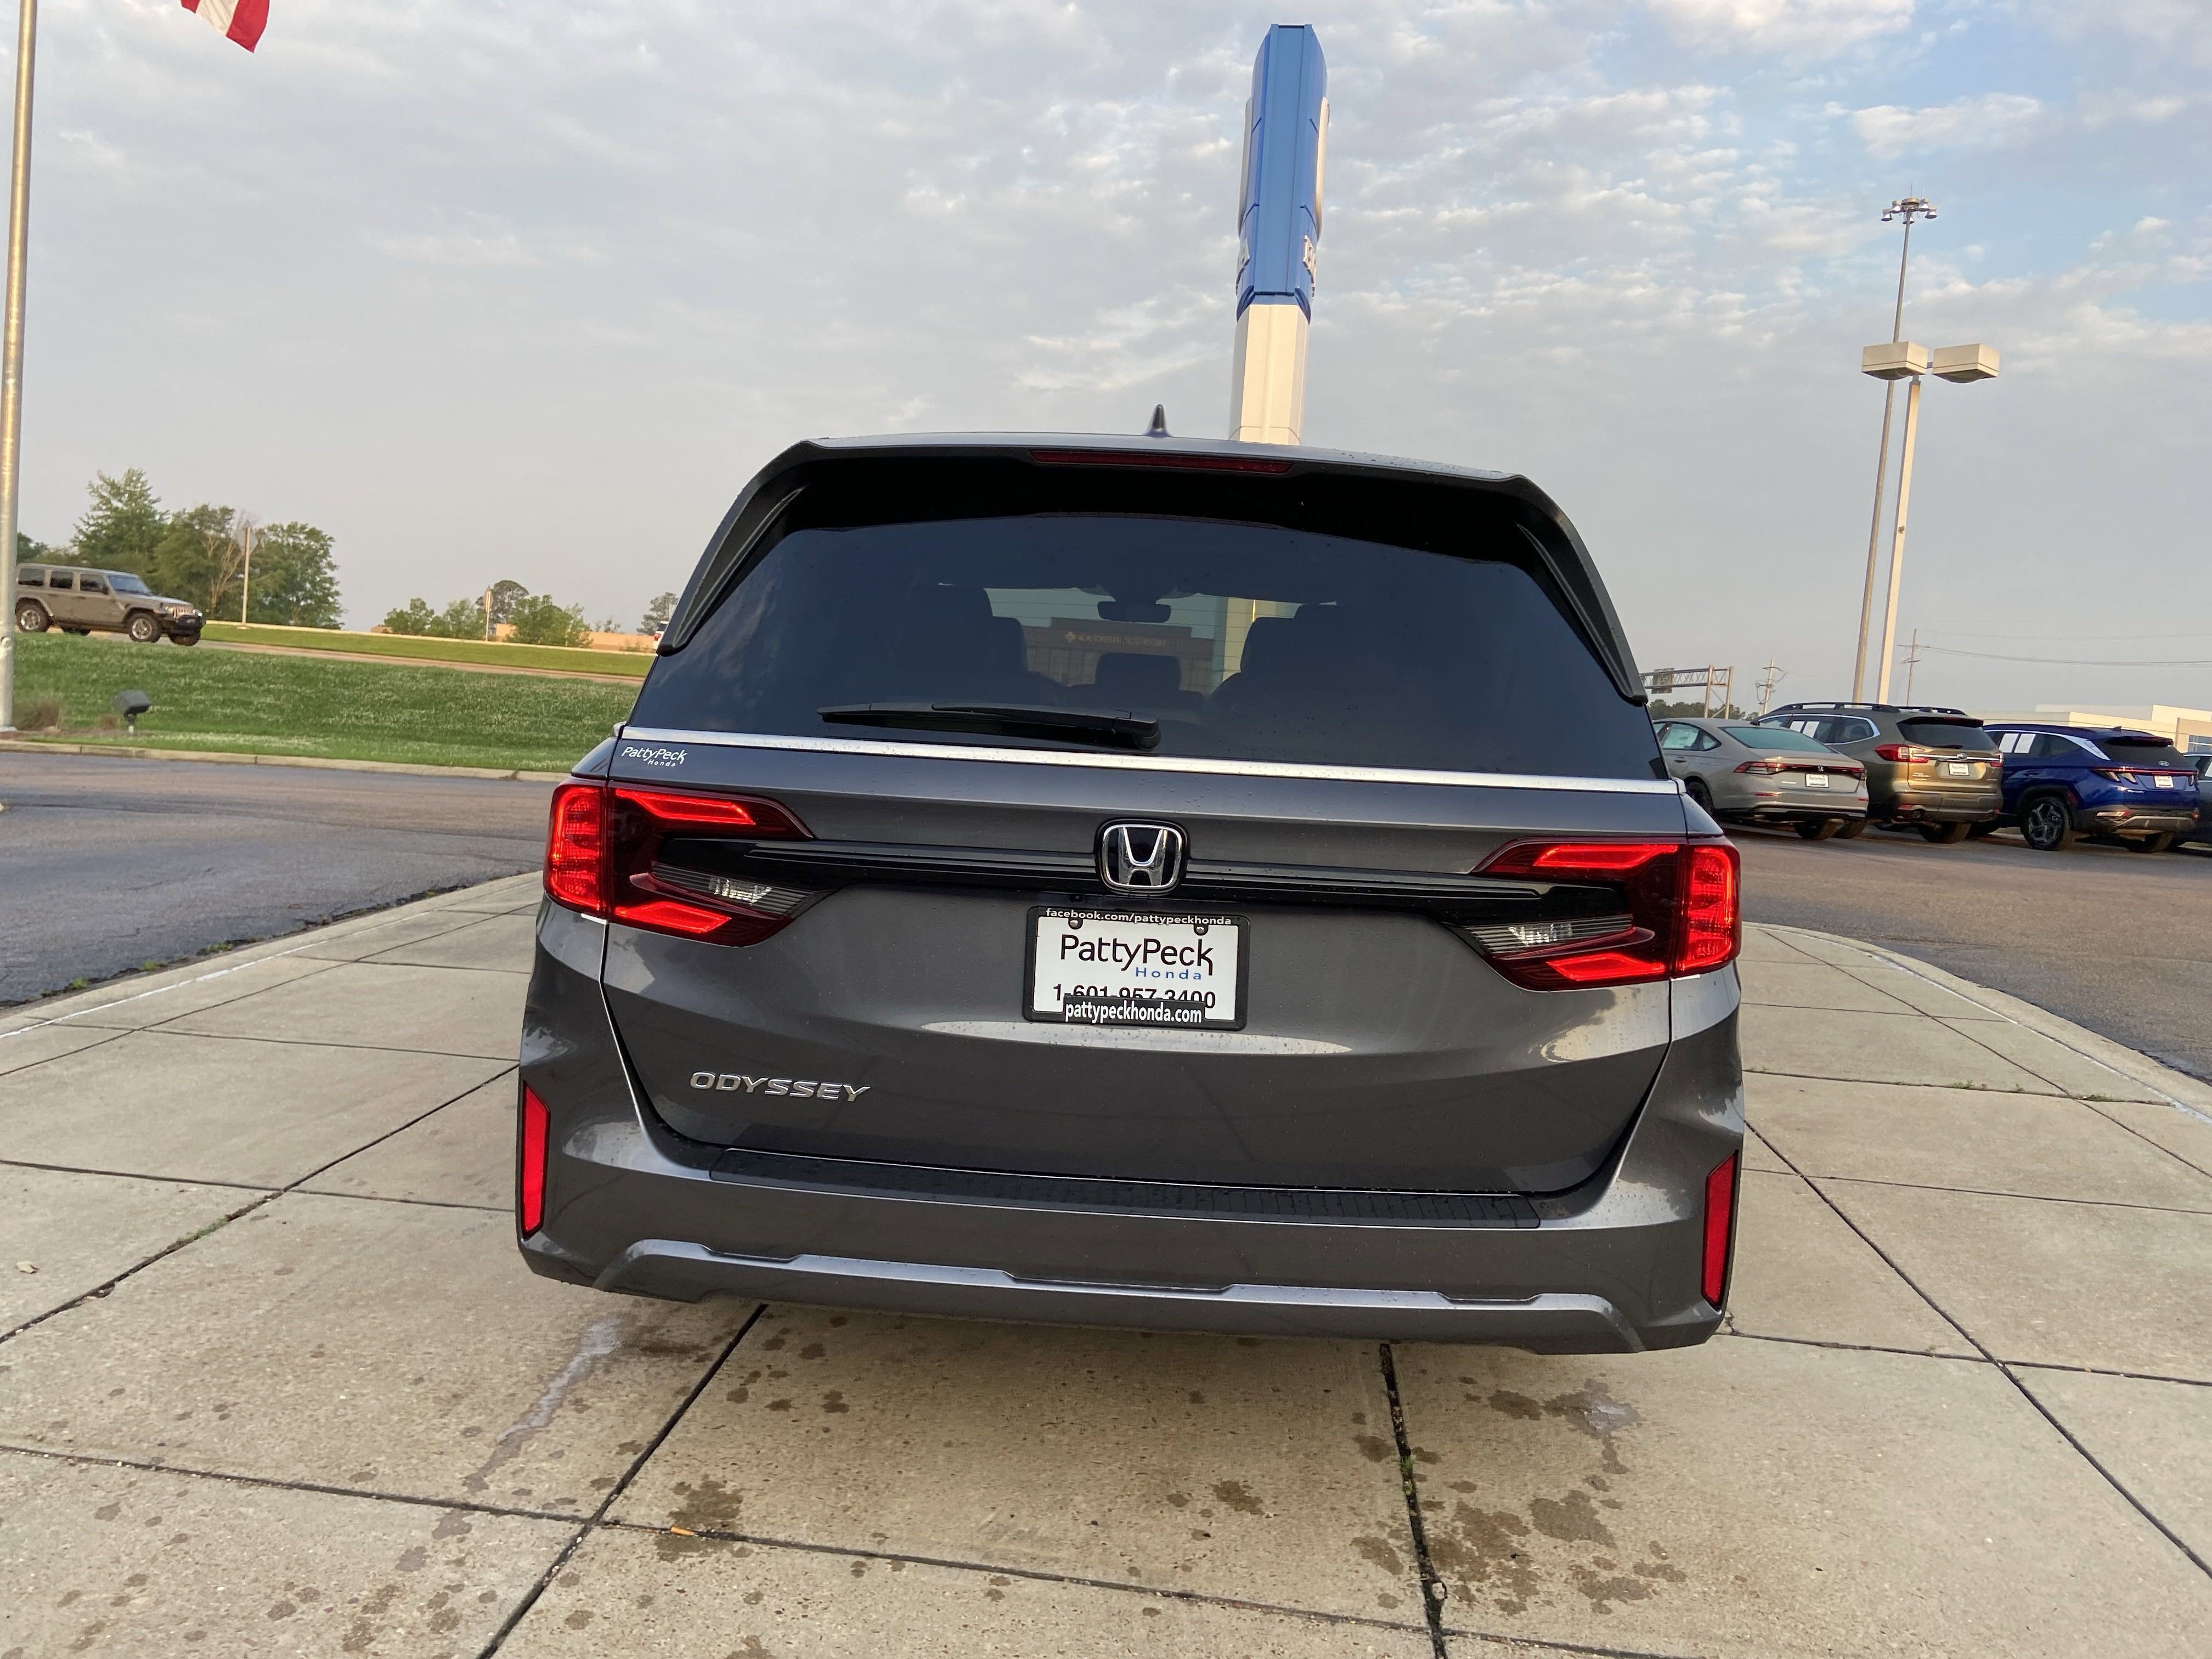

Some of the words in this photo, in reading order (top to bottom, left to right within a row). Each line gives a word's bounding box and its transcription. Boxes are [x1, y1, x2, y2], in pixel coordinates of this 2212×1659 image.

[622, 747, 687, 764] PattyPeck
[1046, 908, 1231, 925] facebook.com/pattypeckhonda
[1060, 934, 1214, 976] PattyPeck
[1136, 967, 1201, 980] Honda
[1065, 1000, 1201, 1023] pattypeckhonda.com
[690, 1071, 871, 1102] ODYSSEY
